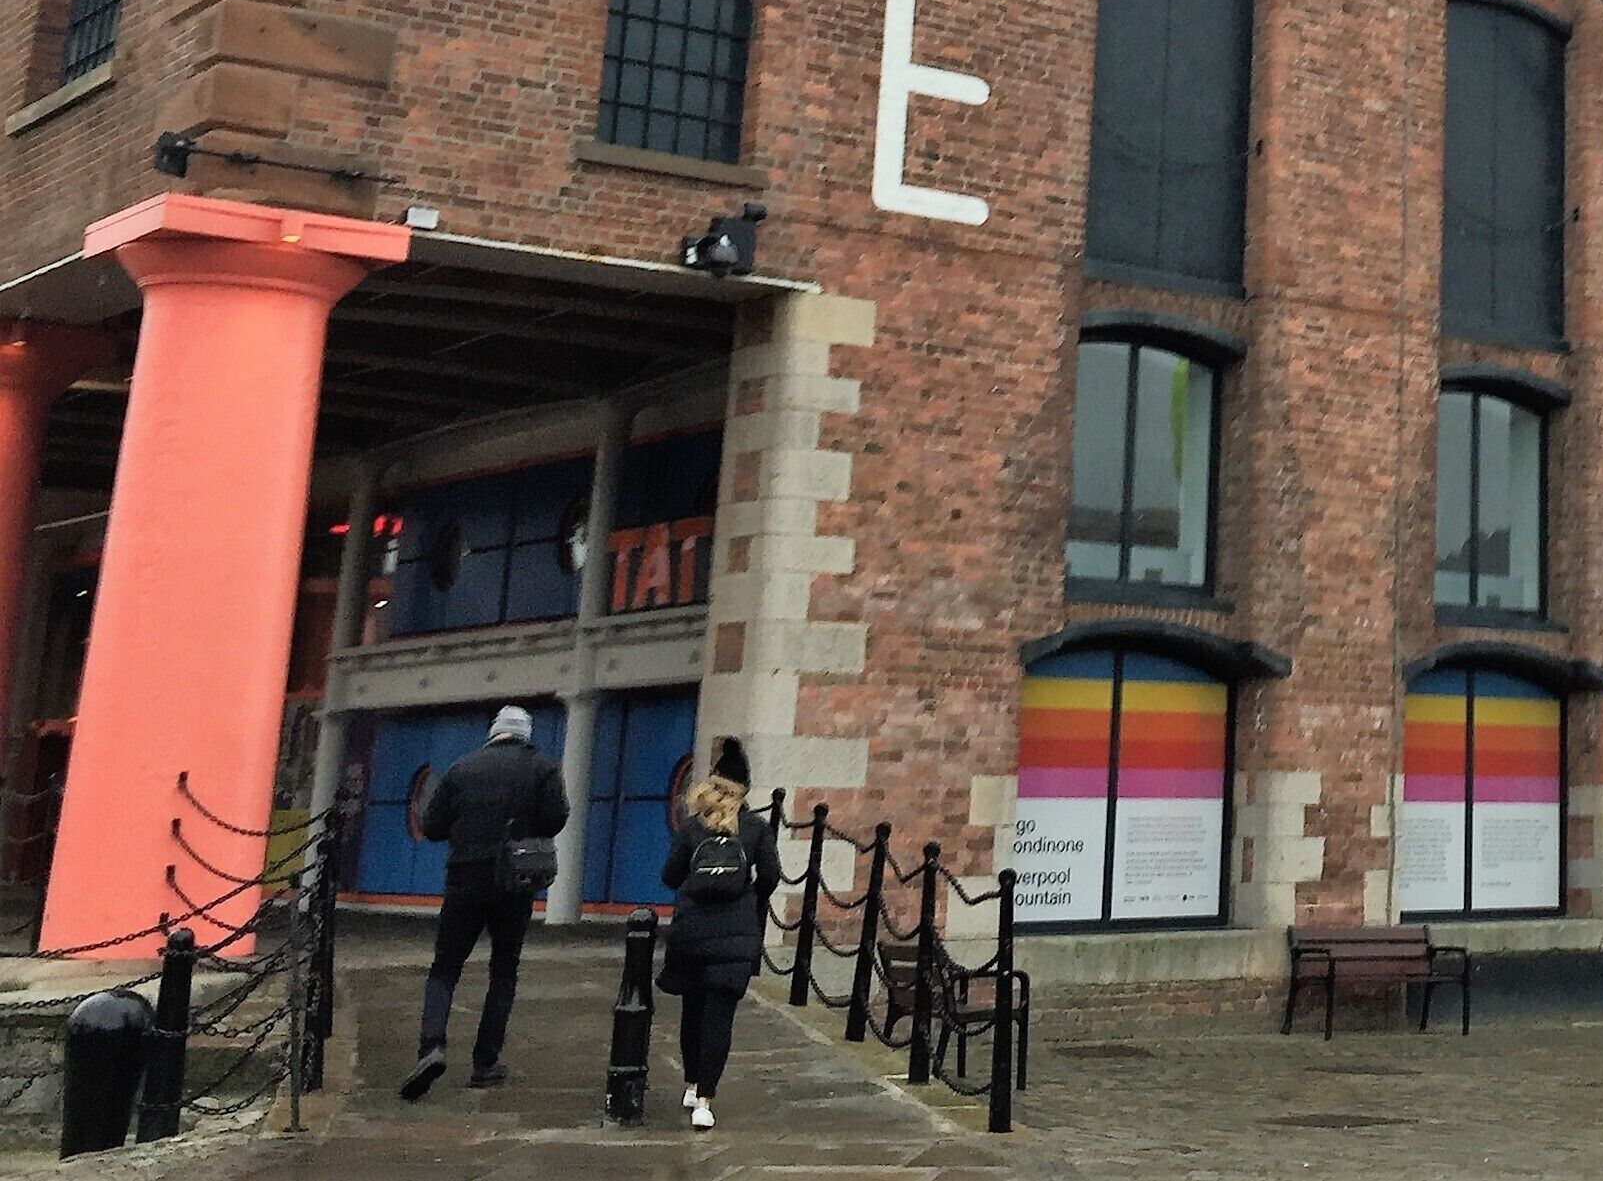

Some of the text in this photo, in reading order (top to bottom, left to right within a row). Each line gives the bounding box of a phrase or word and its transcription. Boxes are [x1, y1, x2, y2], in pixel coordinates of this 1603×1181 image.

[606, 516, 714, 612] TAT
[1016, 819, 1036, 836] go
[1013, 836, 1084, 854] ondinone
[1016, 867, 1071, 887] verpool
[1015, 888, 1072, 906] ountain
